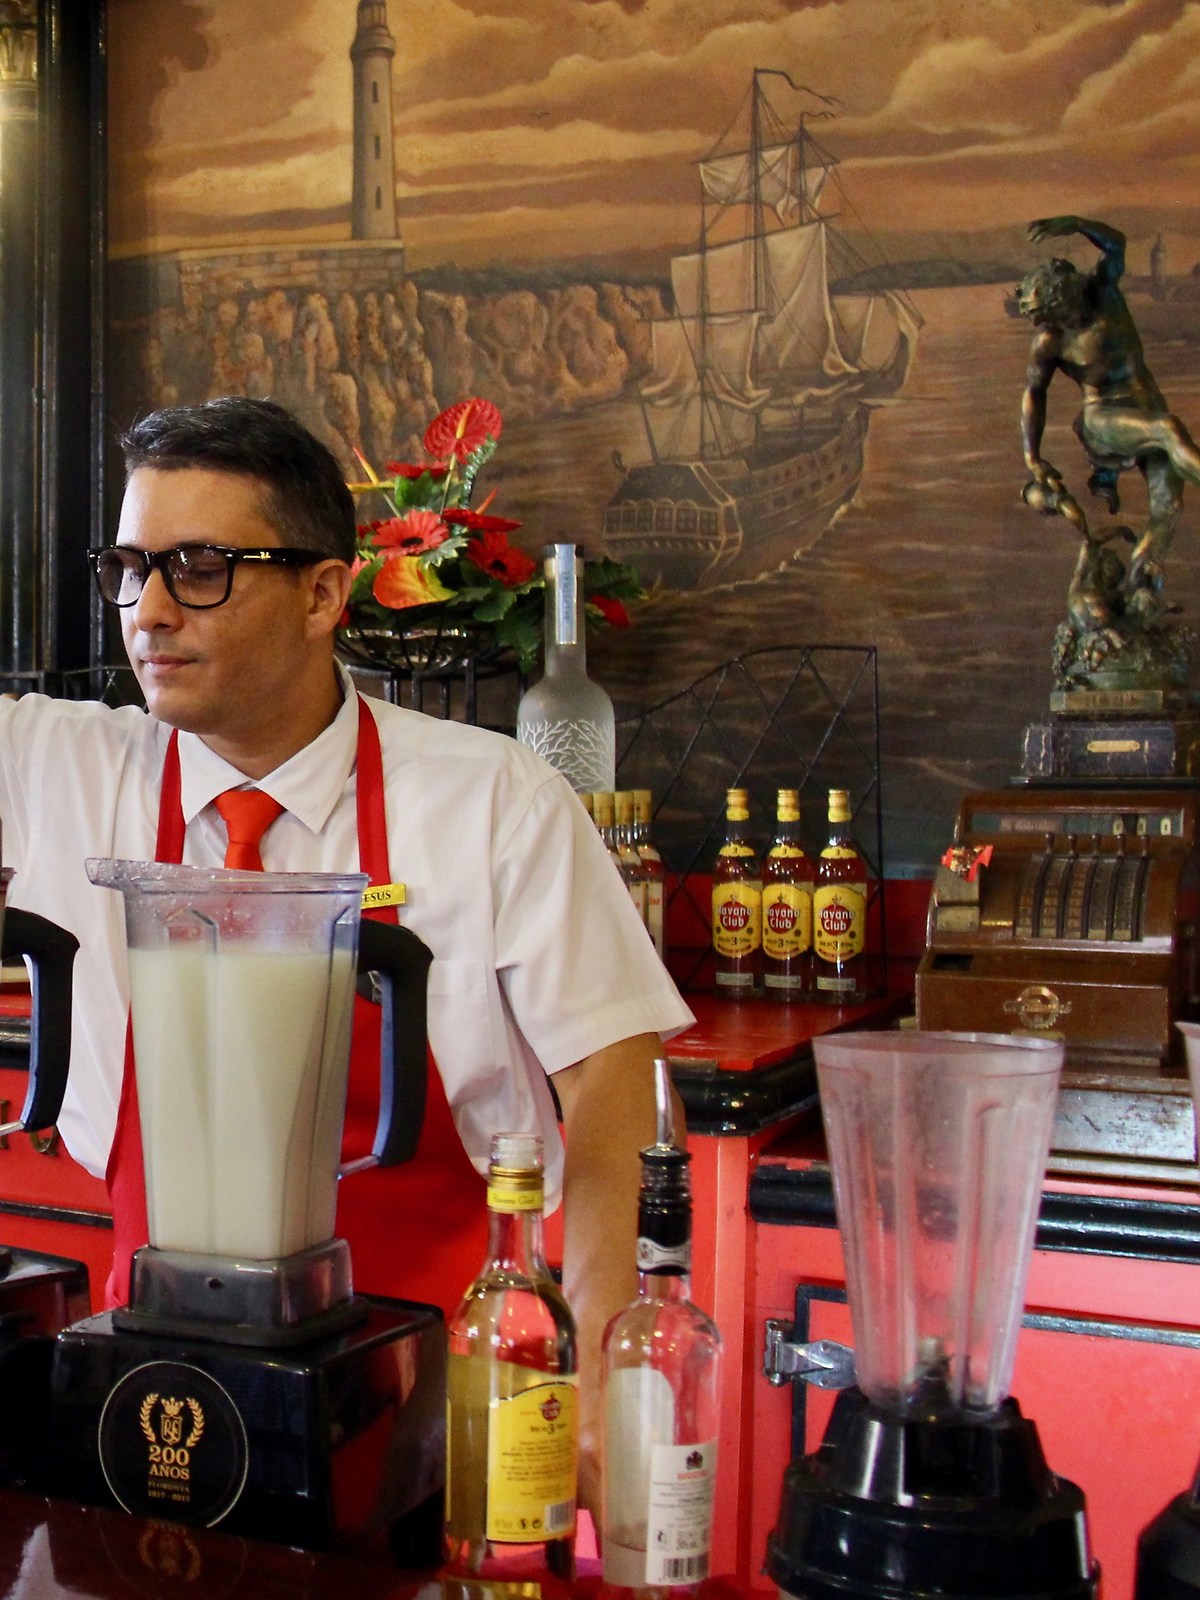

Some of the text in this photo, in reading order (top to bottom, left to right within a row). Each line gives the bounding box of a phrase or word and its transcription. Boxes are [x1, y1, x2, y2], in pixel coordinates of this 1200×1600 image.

[364, 890, 392, 903] ESUS
[722, 916, 746, 927] Club
[770, 917, 792, 929] Club
[824, 919, 847, 931] Club
[148, 1444, 190, 1467] 200
[149, 1462, 190, 1481] AÑOS
